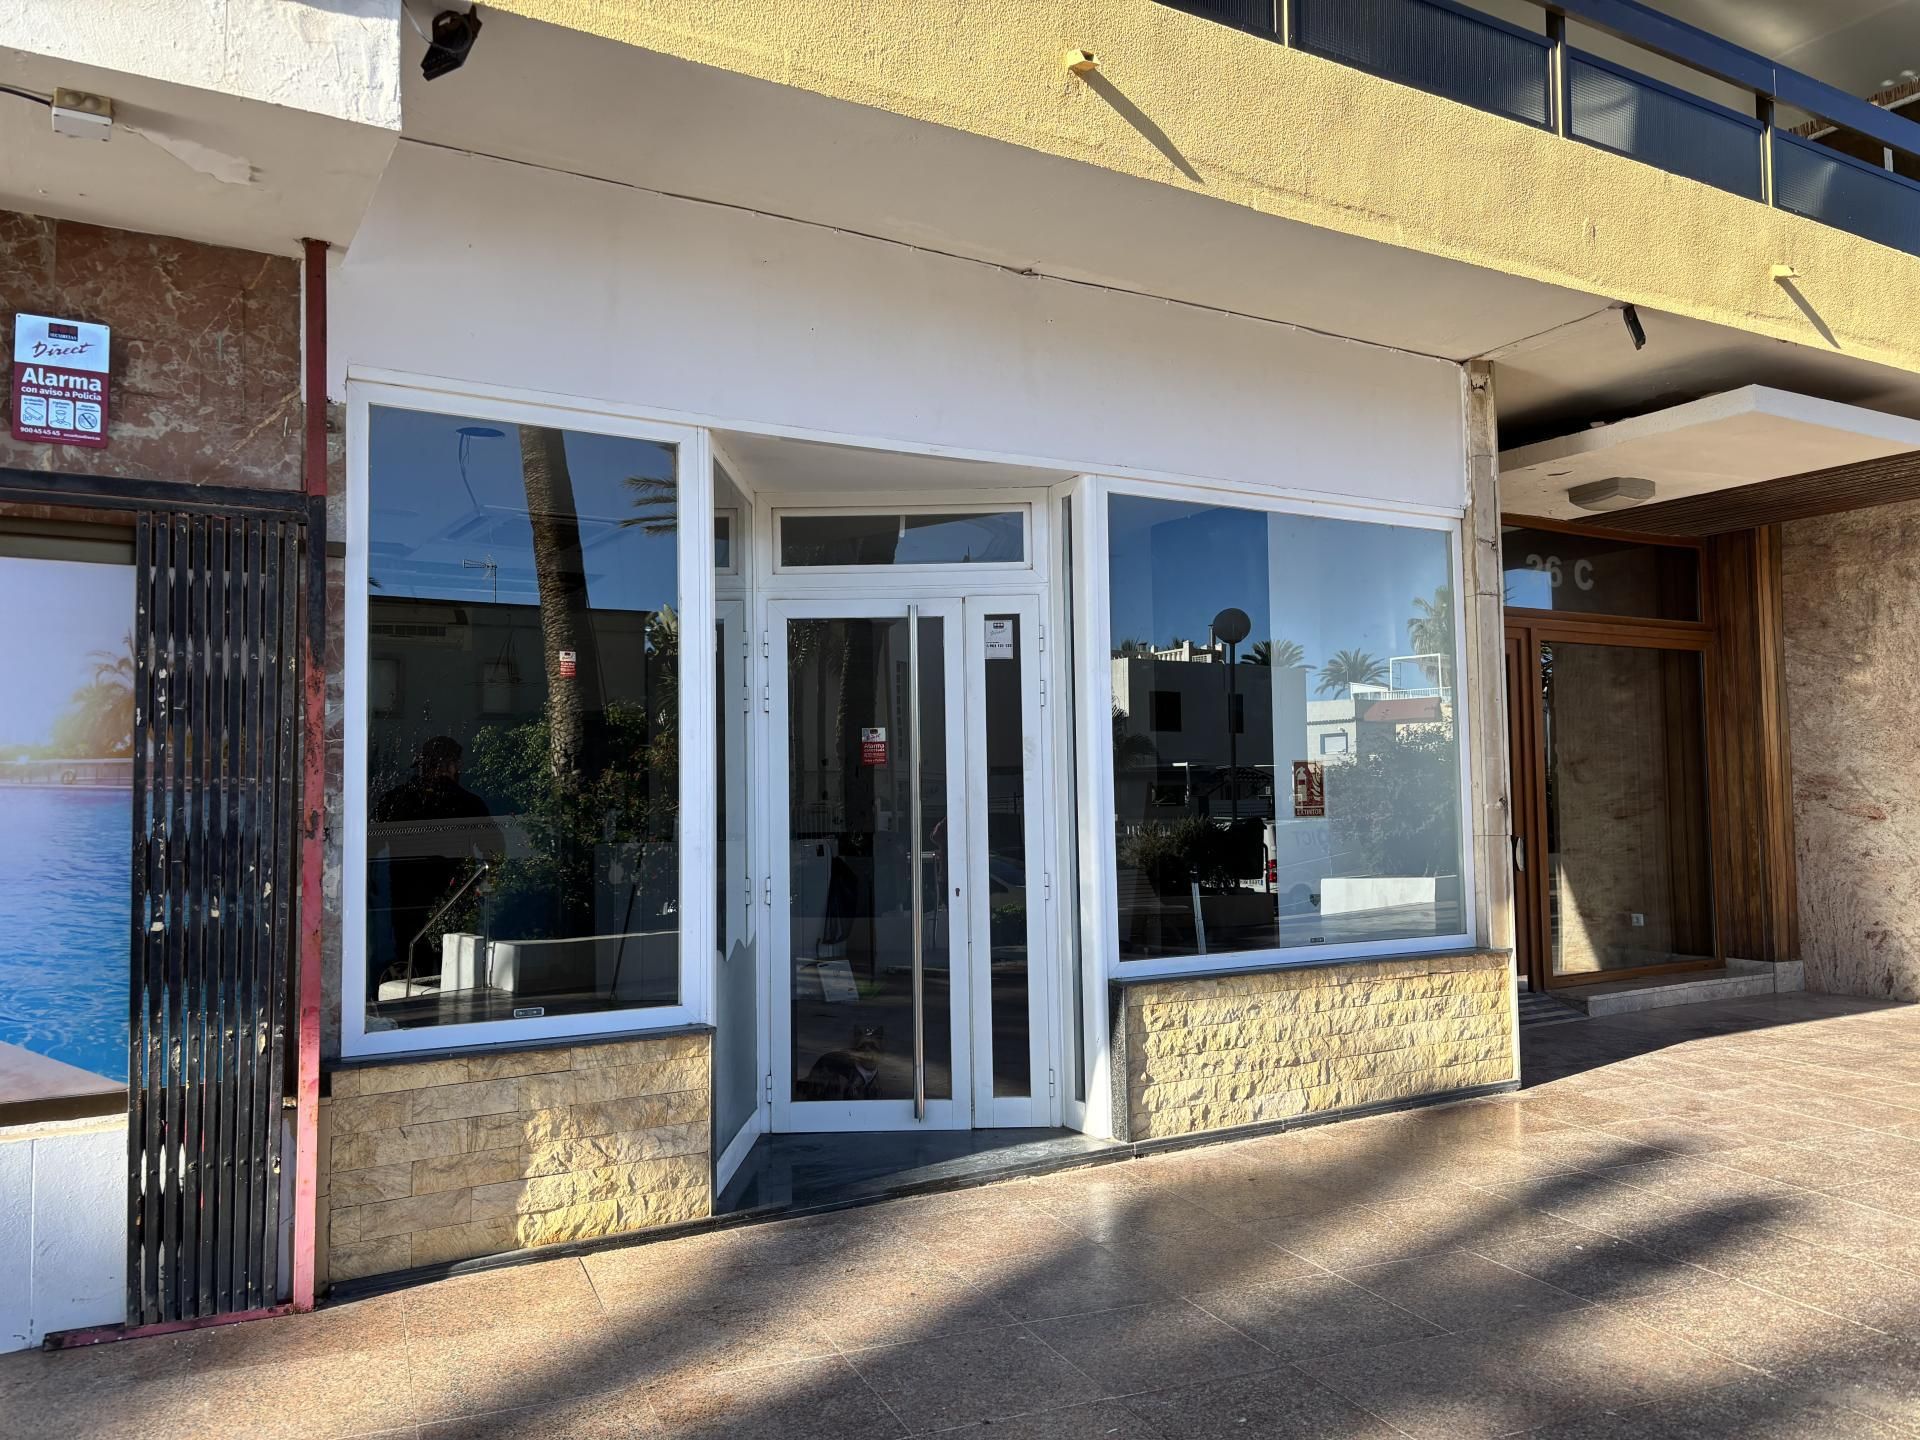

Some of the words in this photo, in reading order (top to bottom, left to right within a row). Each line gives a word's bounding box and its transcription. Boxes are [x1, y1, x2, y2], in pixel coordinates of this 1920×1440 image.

[31, 341, 96, 358] Direct
[21, 367, 102, 392] Alarma
[21, 386, 38, 394] con
[39, 388, 63, 396] aviso
[64, 390, 71, 398] a
[1574, 559, 1594, 591] C
[1297, 808, 1322, 816] EXTINTOR
